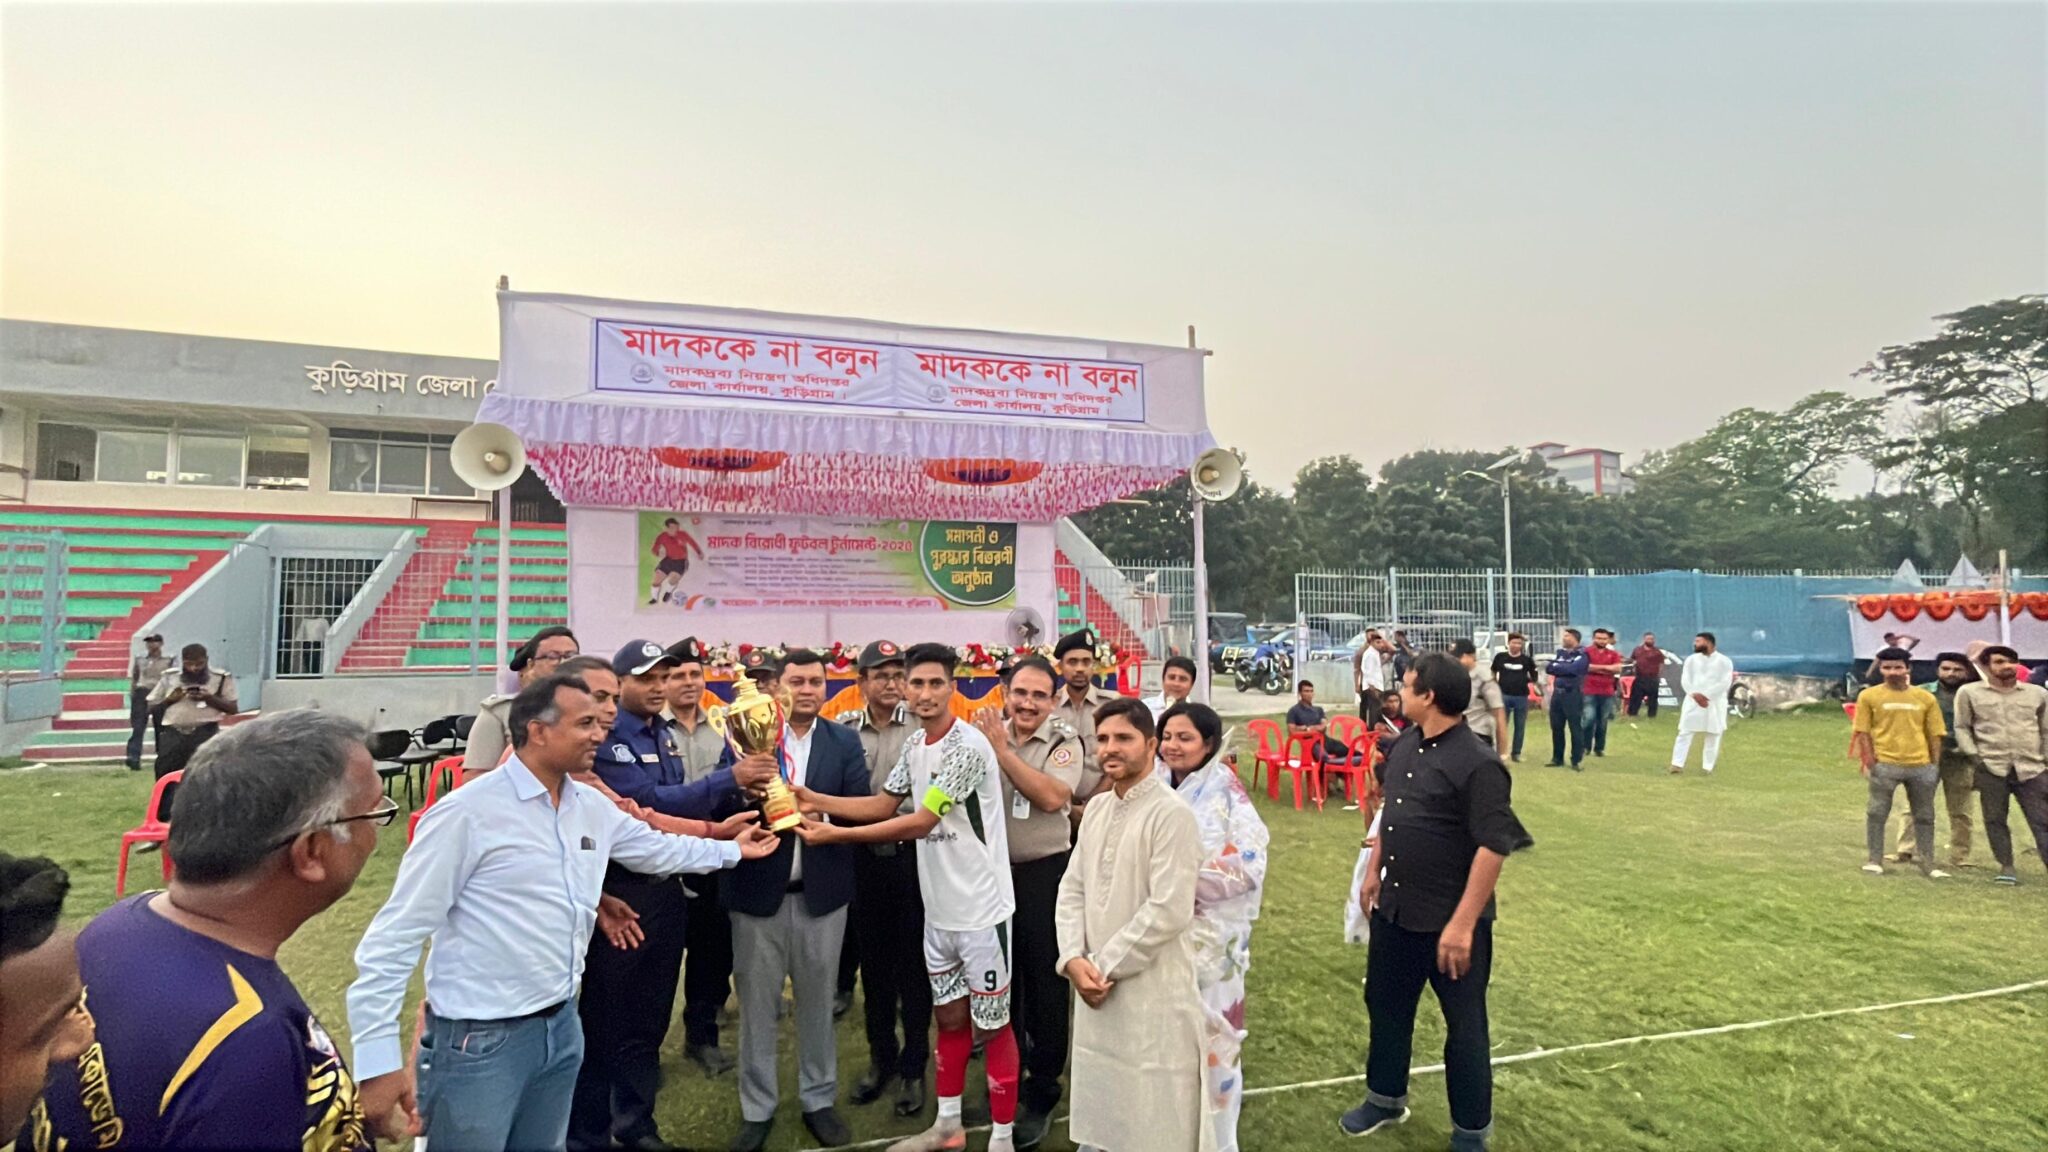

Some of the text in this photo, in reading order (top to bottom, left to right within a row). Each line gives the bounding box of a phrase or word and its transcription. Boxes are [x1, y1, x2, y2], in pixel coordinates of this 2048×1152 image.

[621, 328, 879, 378] মাদককে না বলুন
[304, 360, 408, 394] কুড়িগ্রাম
[416, 374, 478, 398] জেলা
[669, 380, 706, 390] জেলা
[915, 353, 1138, 396] মাদককে না বলুন
[954, 399, 988, 408] জেলা
[707, 536, 742, 549] মাদক
[745, 532, 786, 550] বিরোধী
[788, 534, 829, 555] ফুটবল
[945, 524, 999, 544] সমাপনী ও
[930, 545, 1013, 571] পুরস্কার বিতরণী
[951, 566, 993, 592] অনুষ্ঠান
[984, 969, 997, 992] 9
